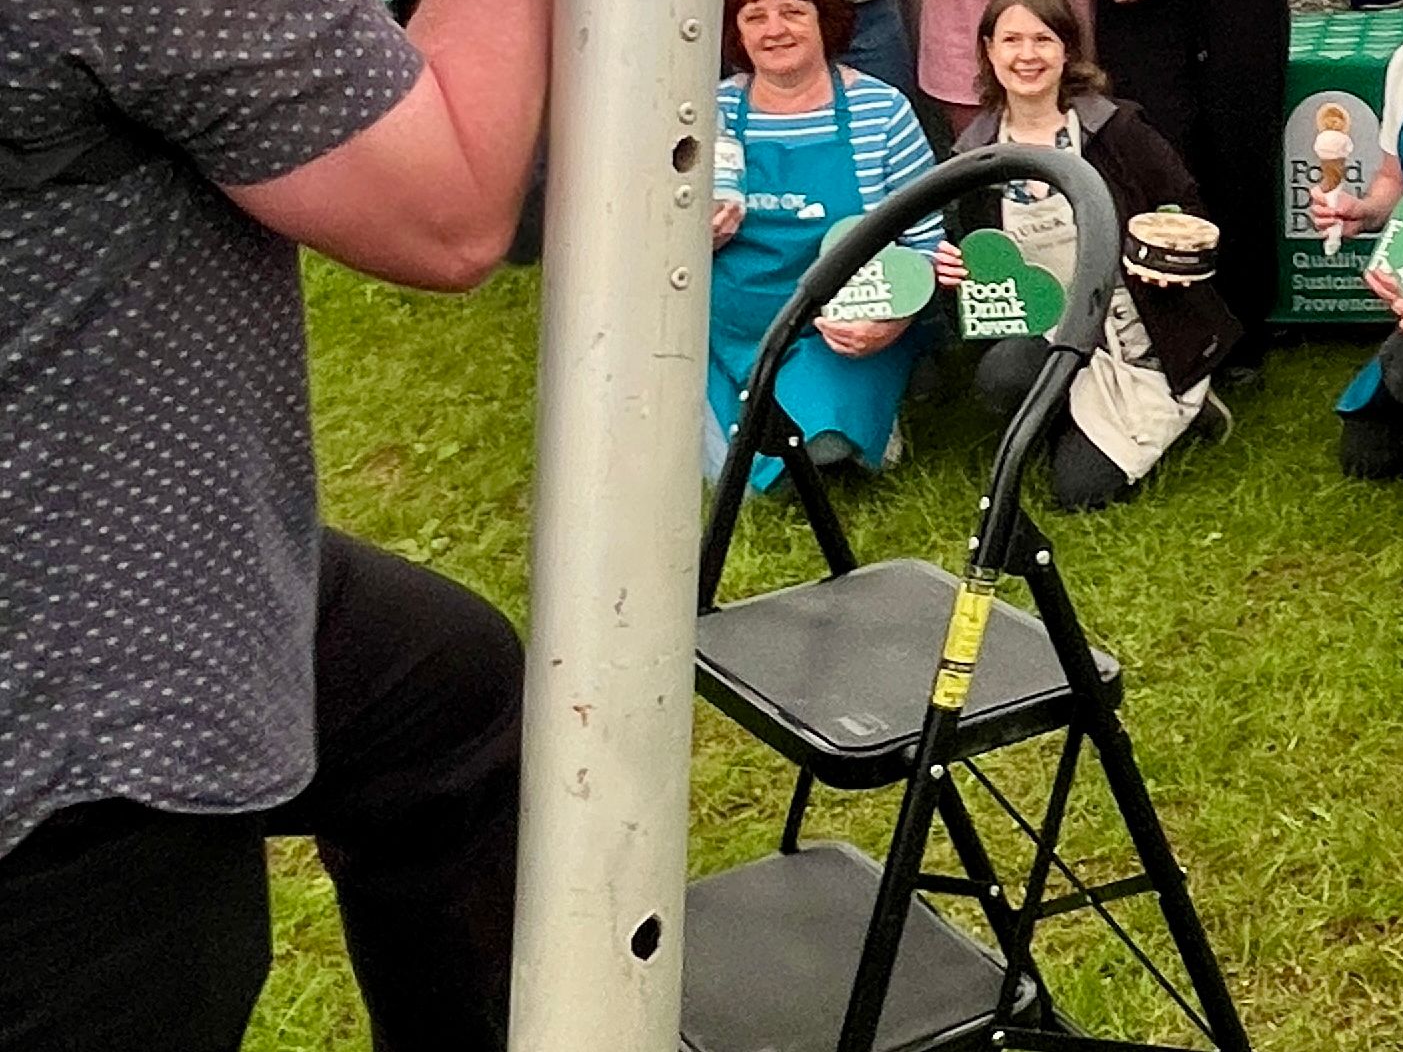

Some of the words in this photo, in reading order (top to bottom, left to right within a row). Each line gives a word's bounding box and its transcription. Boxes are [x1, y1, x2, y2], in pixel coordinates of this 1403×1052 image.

[1290, 160, 1365, 184] Fod
[961, 277, 1018, 300] Food
[961, 296, 1028, 319] Drink
[965, 318, 1030, 336] Devon
